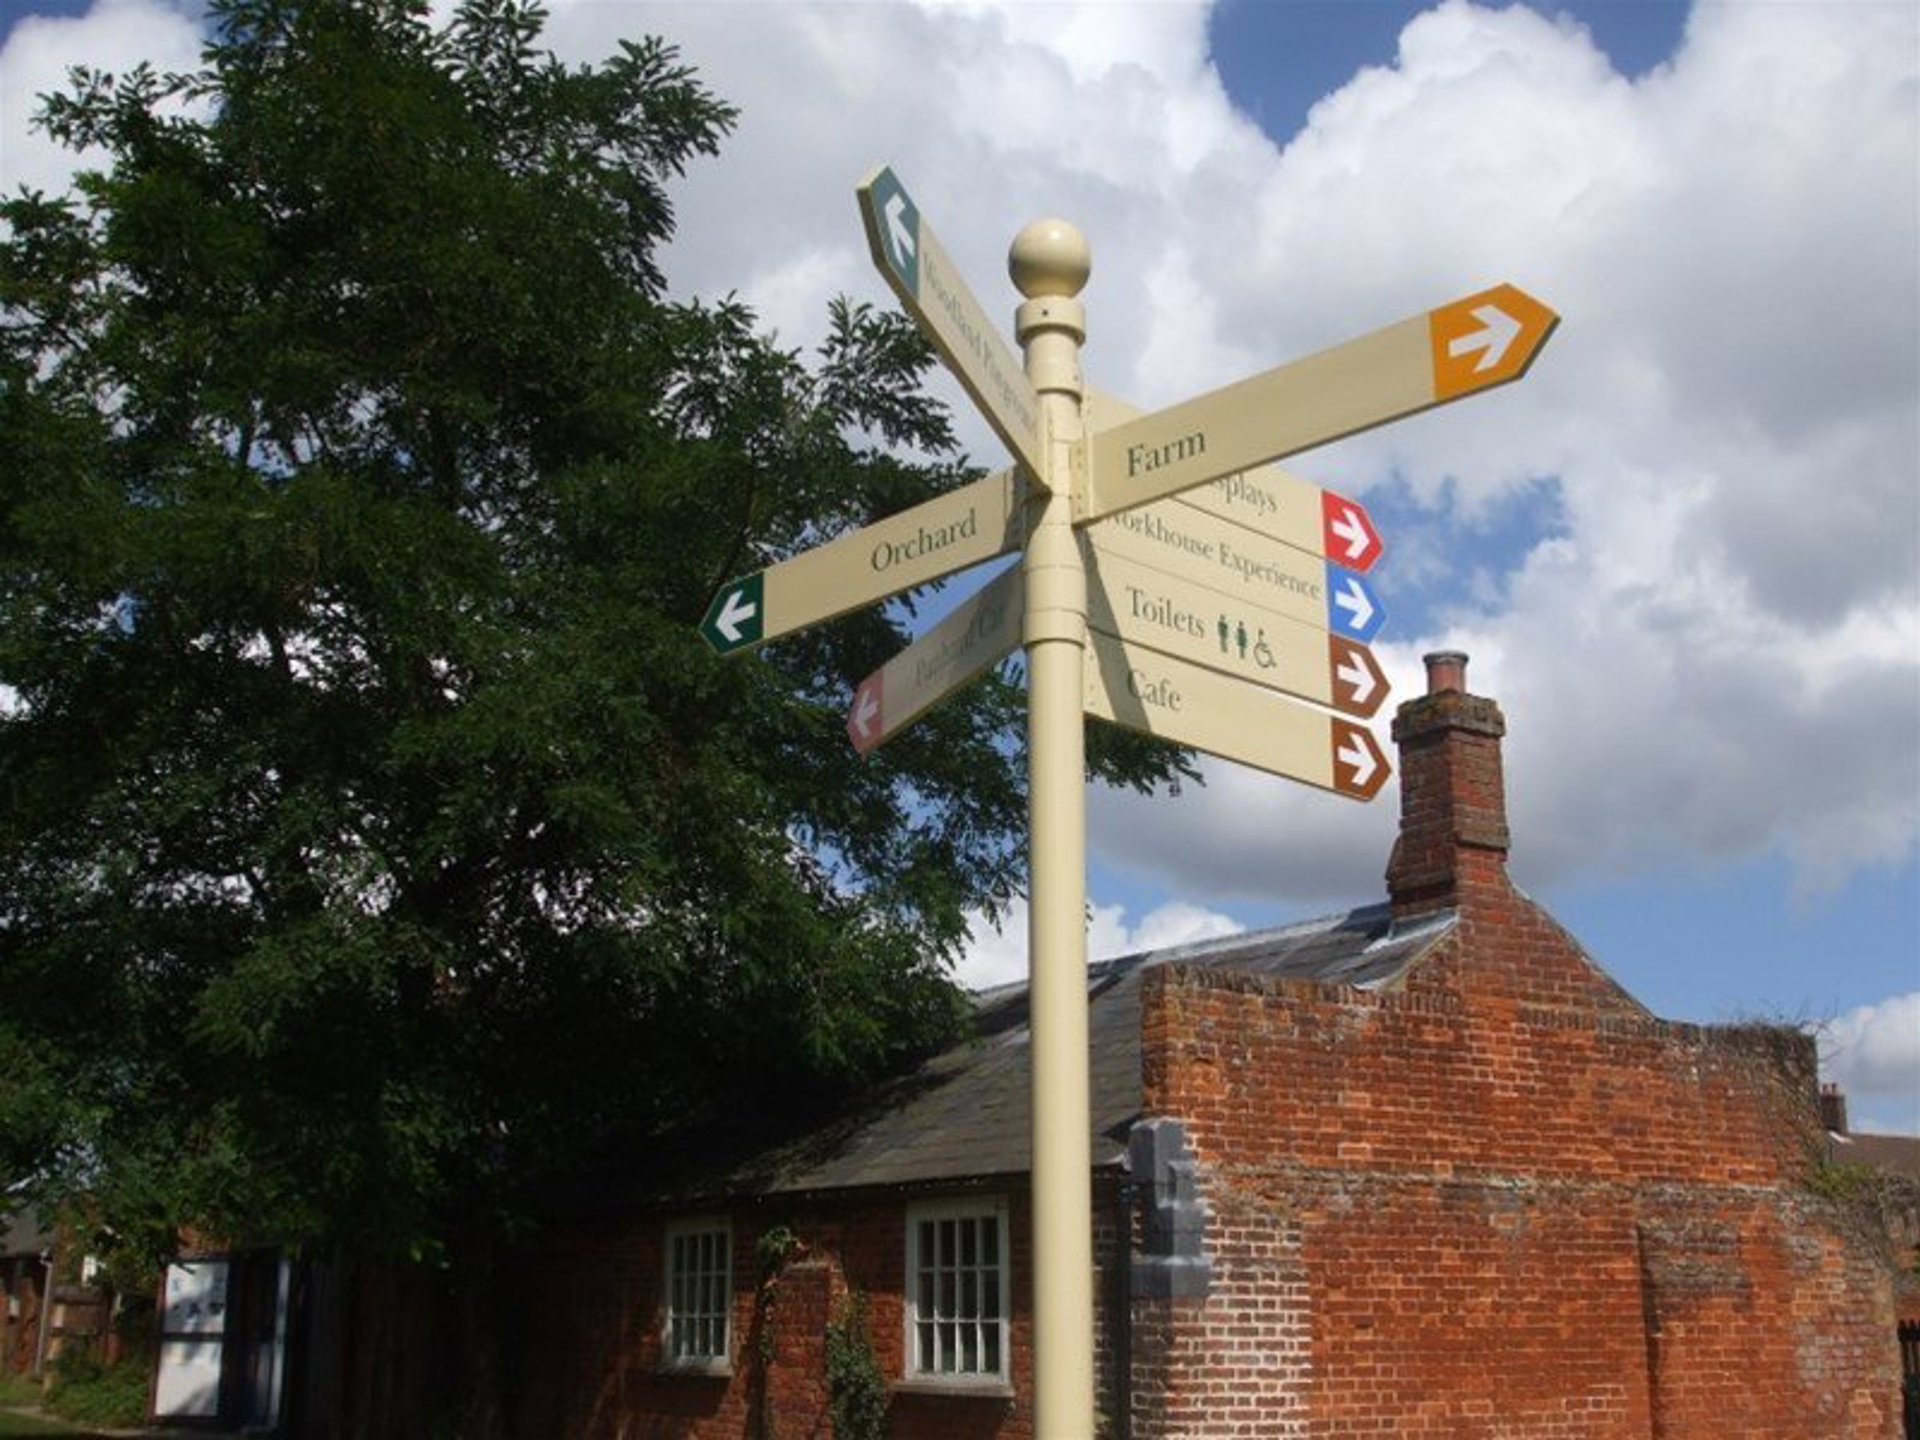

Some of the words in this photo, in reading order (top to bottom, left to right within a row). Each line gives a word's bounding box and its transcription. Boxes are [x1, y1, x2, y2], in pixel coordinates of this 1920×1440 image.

[1127, 431, 1206, 477] Farm
[870, 508, 977, 572] Orchard
[1218, 543, 1321, 599] Experience
[1126, 585, 1205, 639] Toilets
[1127, 667, 1181, 711] Cafe
